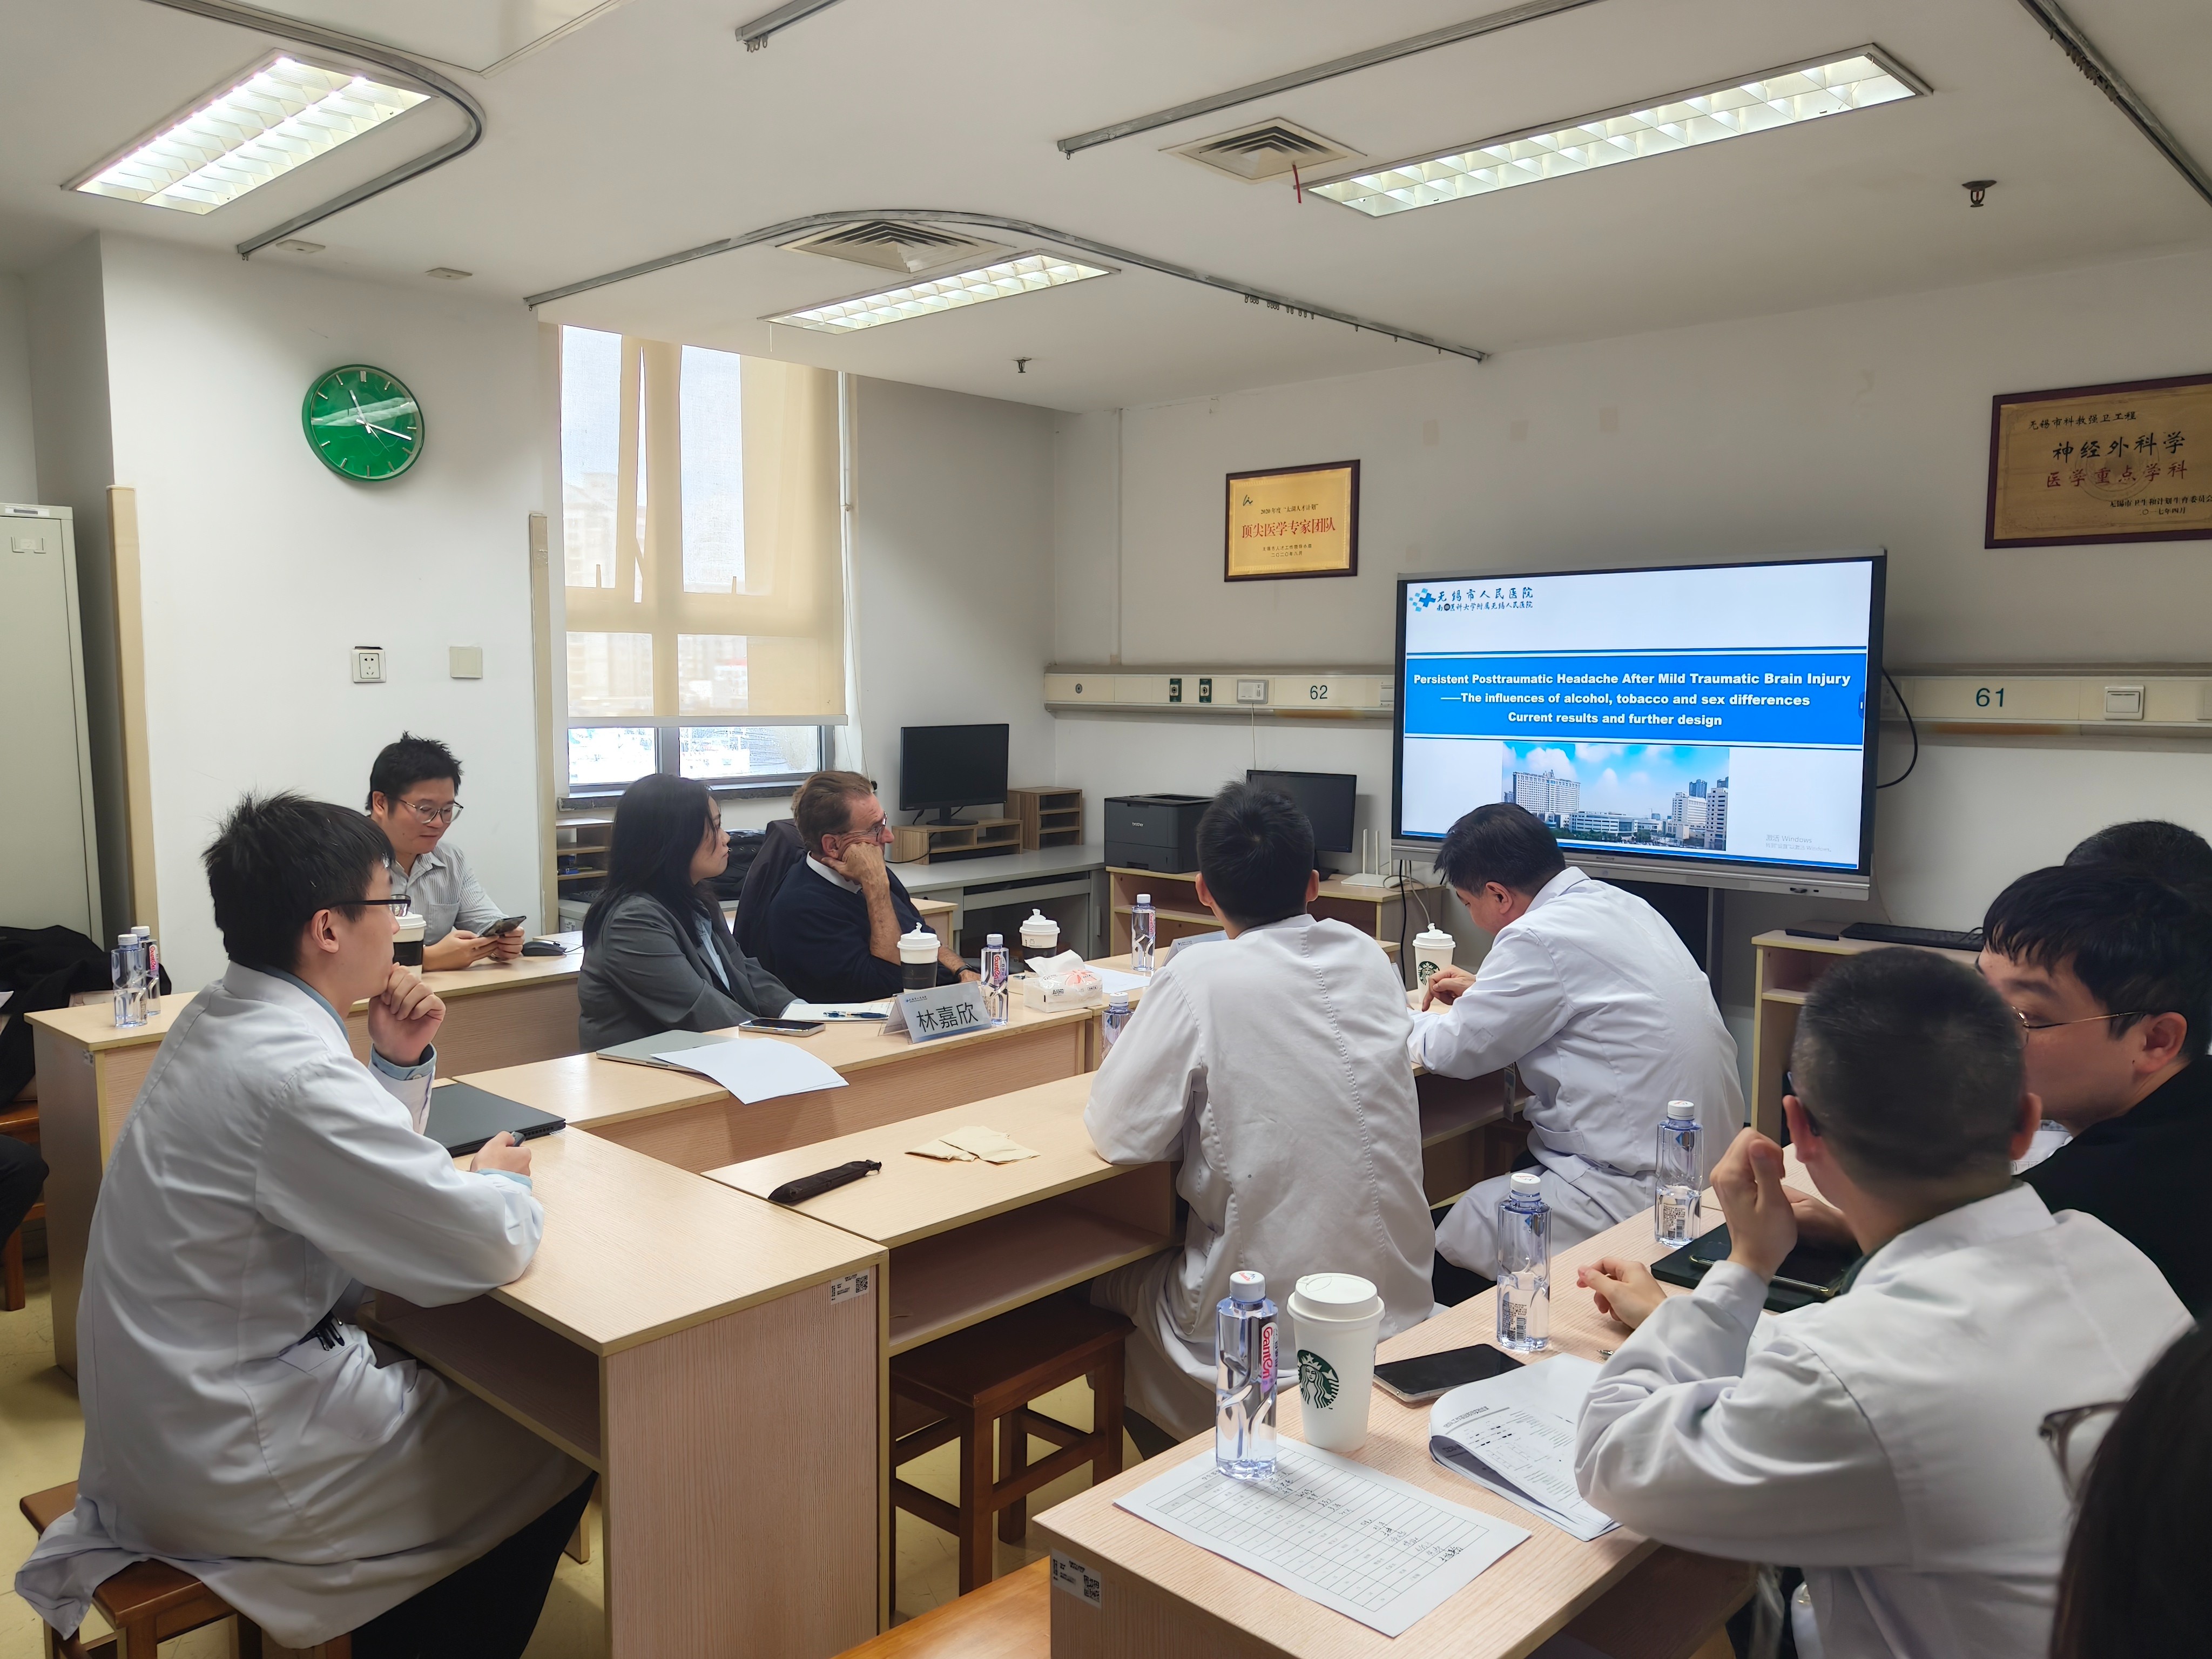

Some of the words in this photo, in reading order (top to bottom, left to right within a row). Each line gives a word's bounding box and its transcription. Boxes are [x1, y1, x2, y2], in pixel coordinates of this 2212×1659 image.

[2028, 412, 2136, 430] 无锡市科教强卫工程
[2053, 431, 2185, 463] 神经外科学
[2047, 460, 2187, 488] 医学重点学科
[1242, 517, 1336, 538] 顶尖医学专家团队
[1437, 587, 1533, 602] 无锡市人民医院
[1437, 601, 1533, 611] 南医科大学附属无锡人民医院
[1414, 675, 1469, 684] Persistent
[1472, 673, 1553, 684] Posttraumatic
[1557, 673, 1619, 684] Headache
[1622, 673, 1655, 684] After
[1658, 673, 1685, 684] Mild
[1690, 673, 1759, 684] Traumatic
[1764, 673, 1803, 684] Brain
[1807, 673, 1851, 686] Injury
[1310, 685, 1328, 700] 62
[1485, 693, 1545, 703] influences
[1548, 693, 1560, 703] of
[1564, 693, 1613, 705] alcohol,
[1616, 694, 1669, 704] tobacco
[1673, 694, 1697, 704] and
[1701, 697, 1725, 705] sex
[1729, 694, 1810, 706] differences
[1975, 688, 2005, 707] 61
[1508, 712, 1553, 723] Current
[1556, 713, 1599, 723] results
[1602, 713, 1625, 724] and
[1629, 714, 1674, 725] further
[1677, 714, 1722, 727] design
[1782, 835, 1812, 844] Windows
[916, 1002, 979, 1032] 林嘉欣
